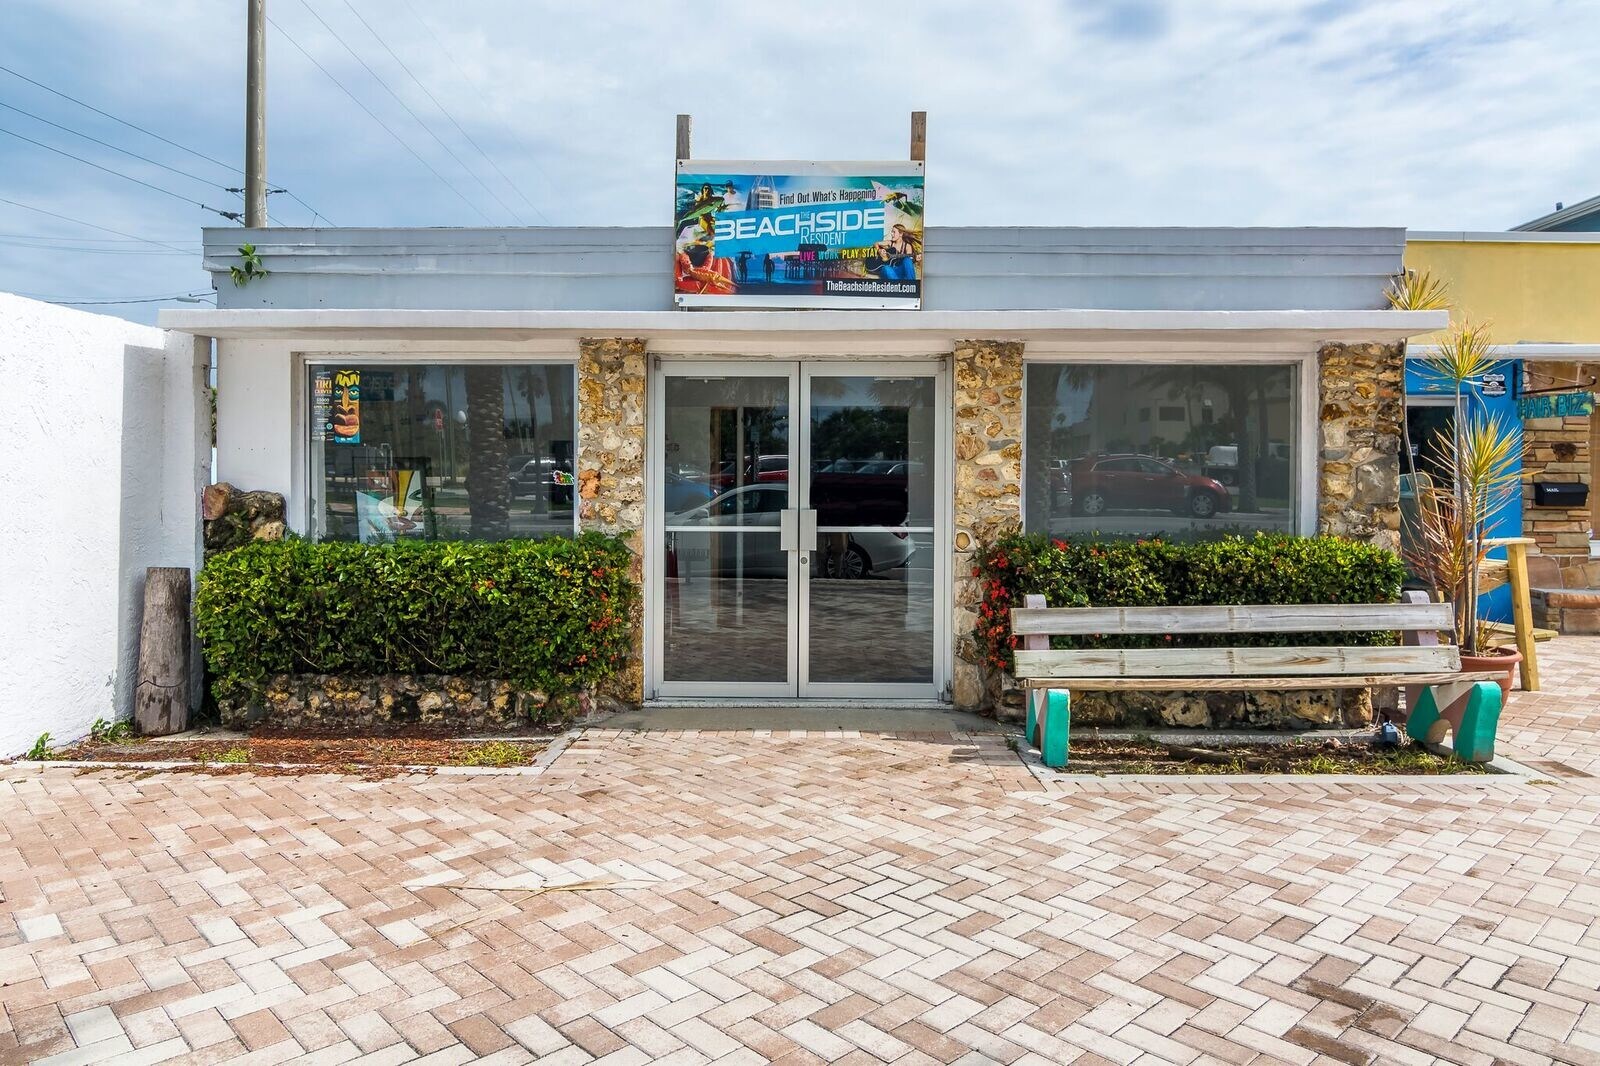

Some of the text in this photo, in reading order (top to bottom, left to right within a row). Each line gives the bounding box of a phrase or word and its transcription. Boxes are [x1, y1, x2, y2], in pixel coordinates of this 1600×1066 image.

[780, 188, 876, 204] Find Out What's Happening
[714, 208, 885, 241] BEACHSIDE
[800, 248, 878, 261] LIVE WORK PLAY STAY
[826, 280, 916, 293] TheBeachsideResident.com
[314, 380, 332, 388] TIKI
[1519, 393, 1588, 418] HAIR BIZ
